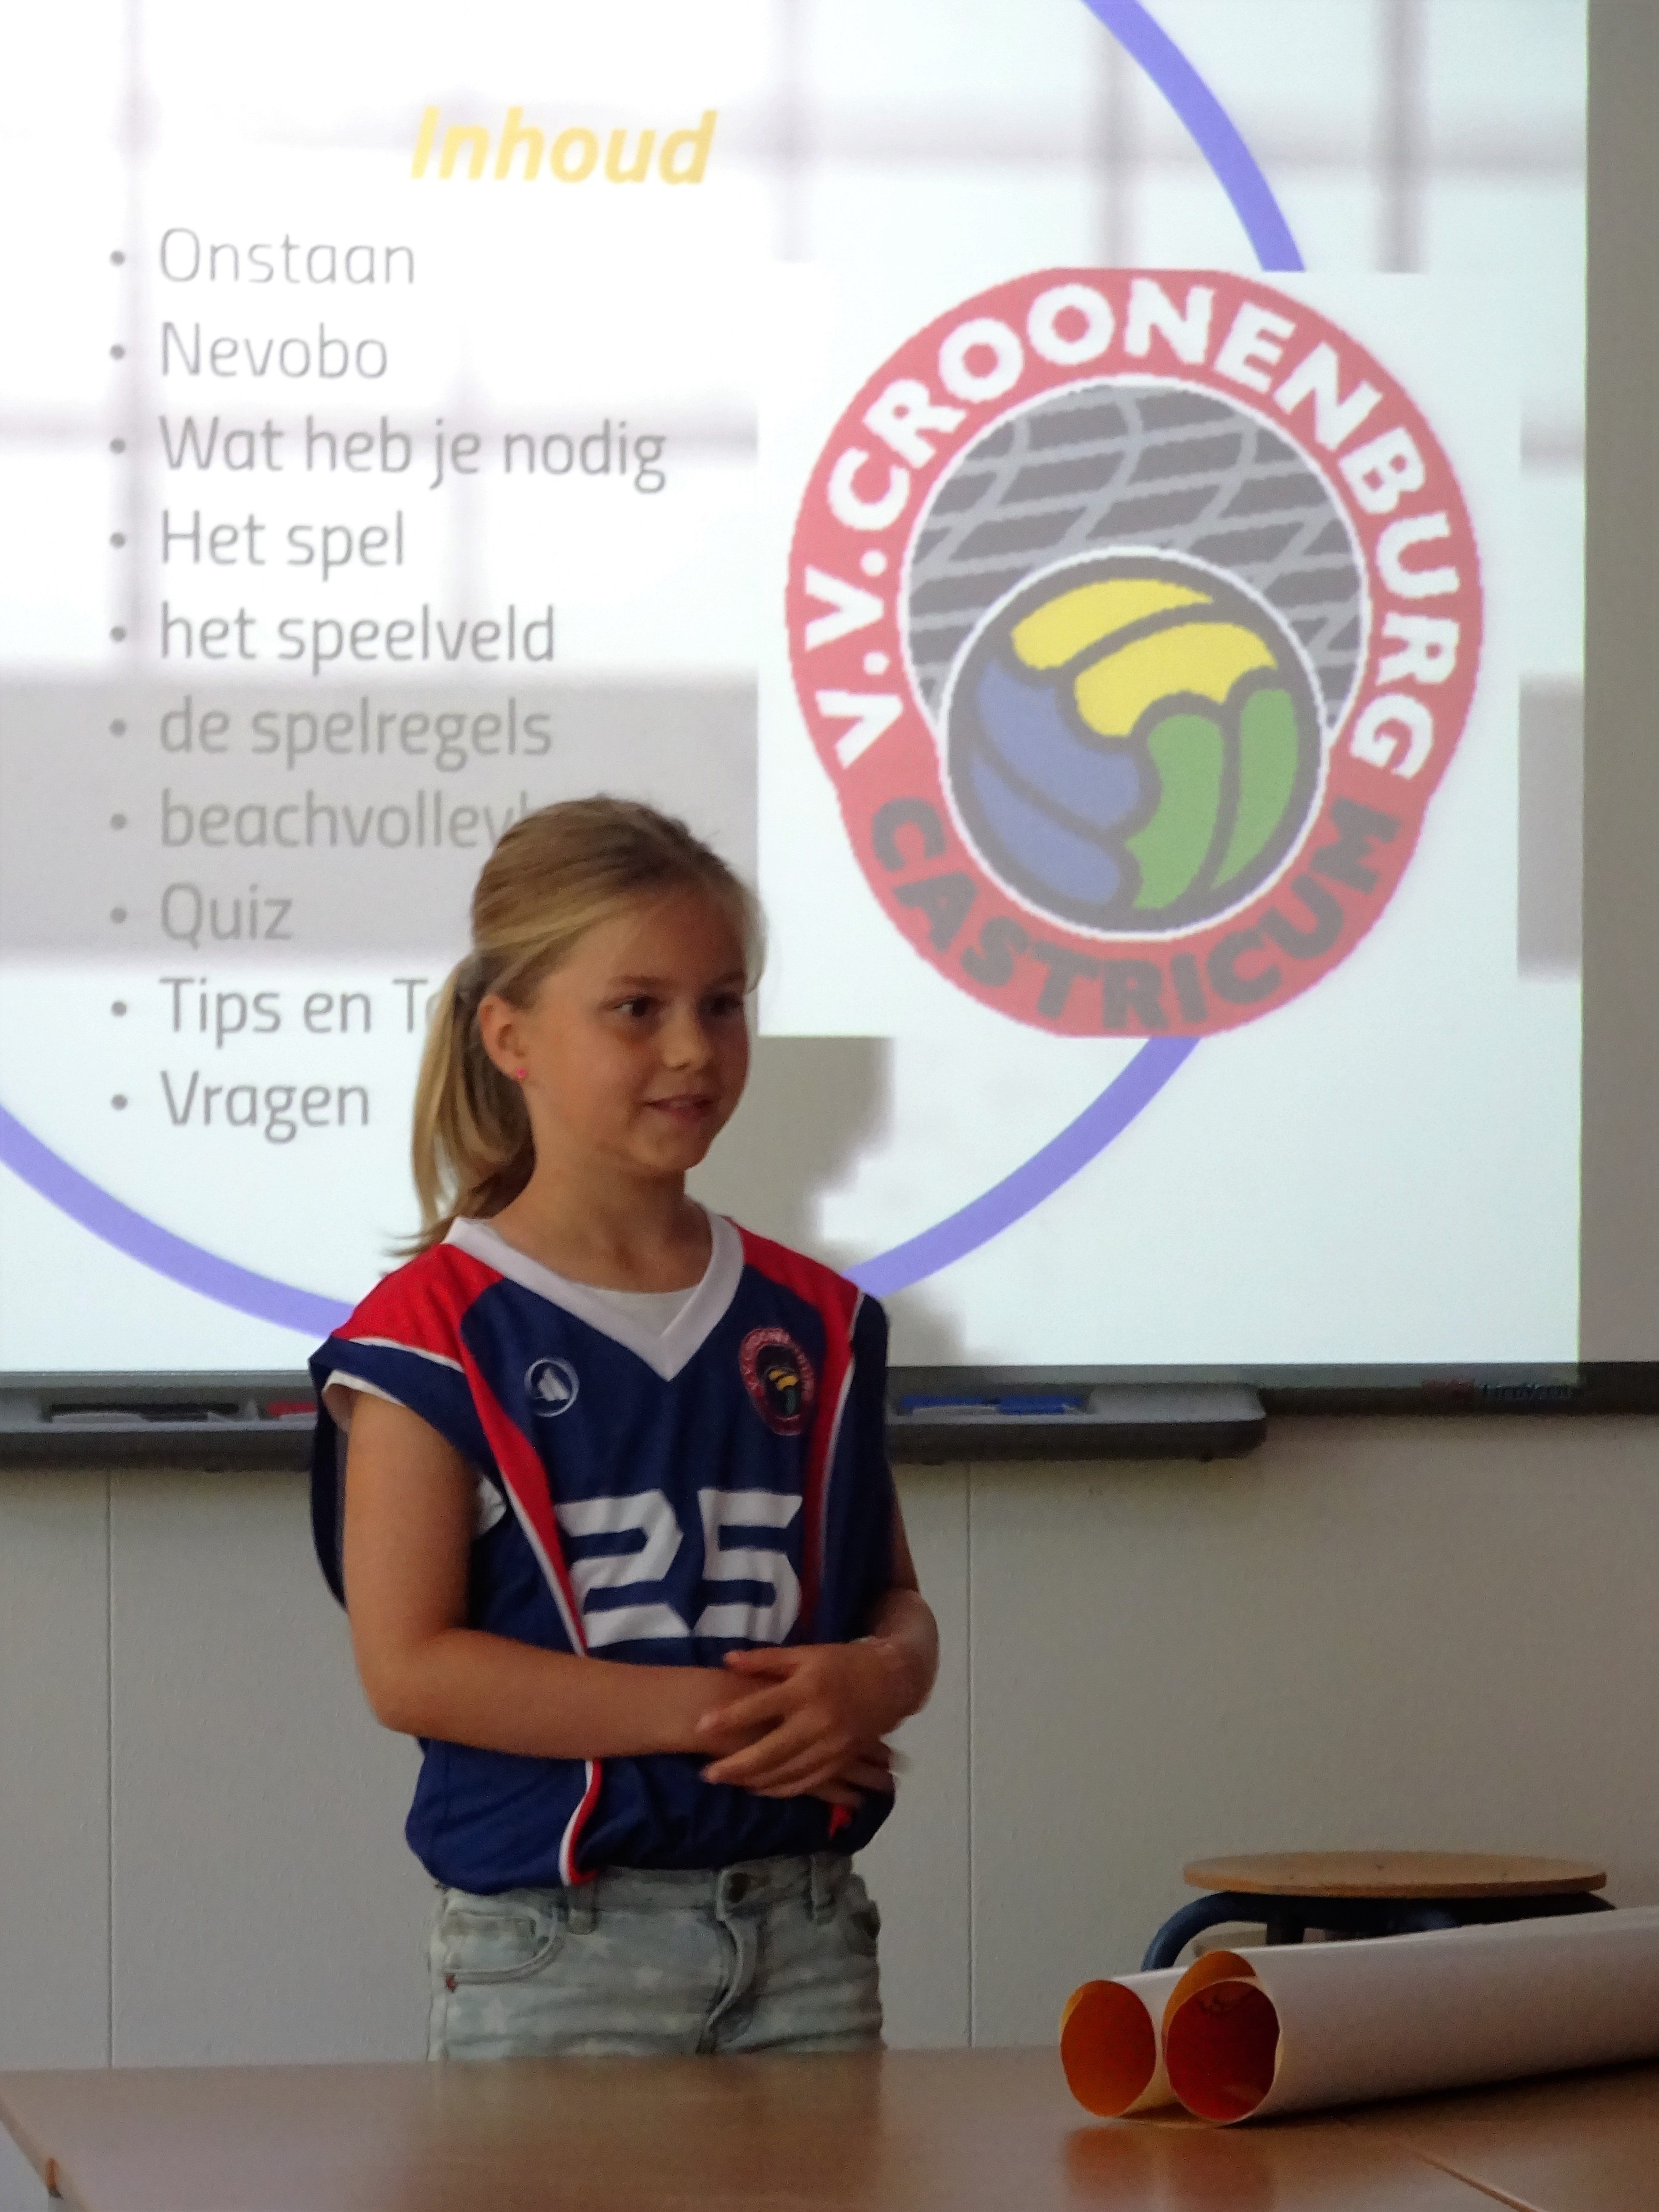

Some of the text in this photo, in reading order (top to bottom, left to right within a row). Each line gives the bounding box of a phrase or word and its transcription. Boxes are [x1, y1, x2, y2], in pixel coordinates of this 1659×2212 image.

[411, 107, 718, 184] Inhoud
[159, 227, 416, 285] Onstaan
[161, 321, 389, 379] Nevobo
[158, 414, 670, 495] Wat heb je nodig
[161, 509, 405, 582] Het spel
[160, 601, 555, 677] het speelveld
[160, 693, 553, 772] de spelregels
[160, 882, 294, 950] Quiz
[870, 796, 1402, 1030] CASTRICUM
[159, 976, 281, 1050] Tips
[303, 991, 373, 1035] en
[160, 1070, 371, 1144] Vragen
[553, 1488, 803, 1648] 25
